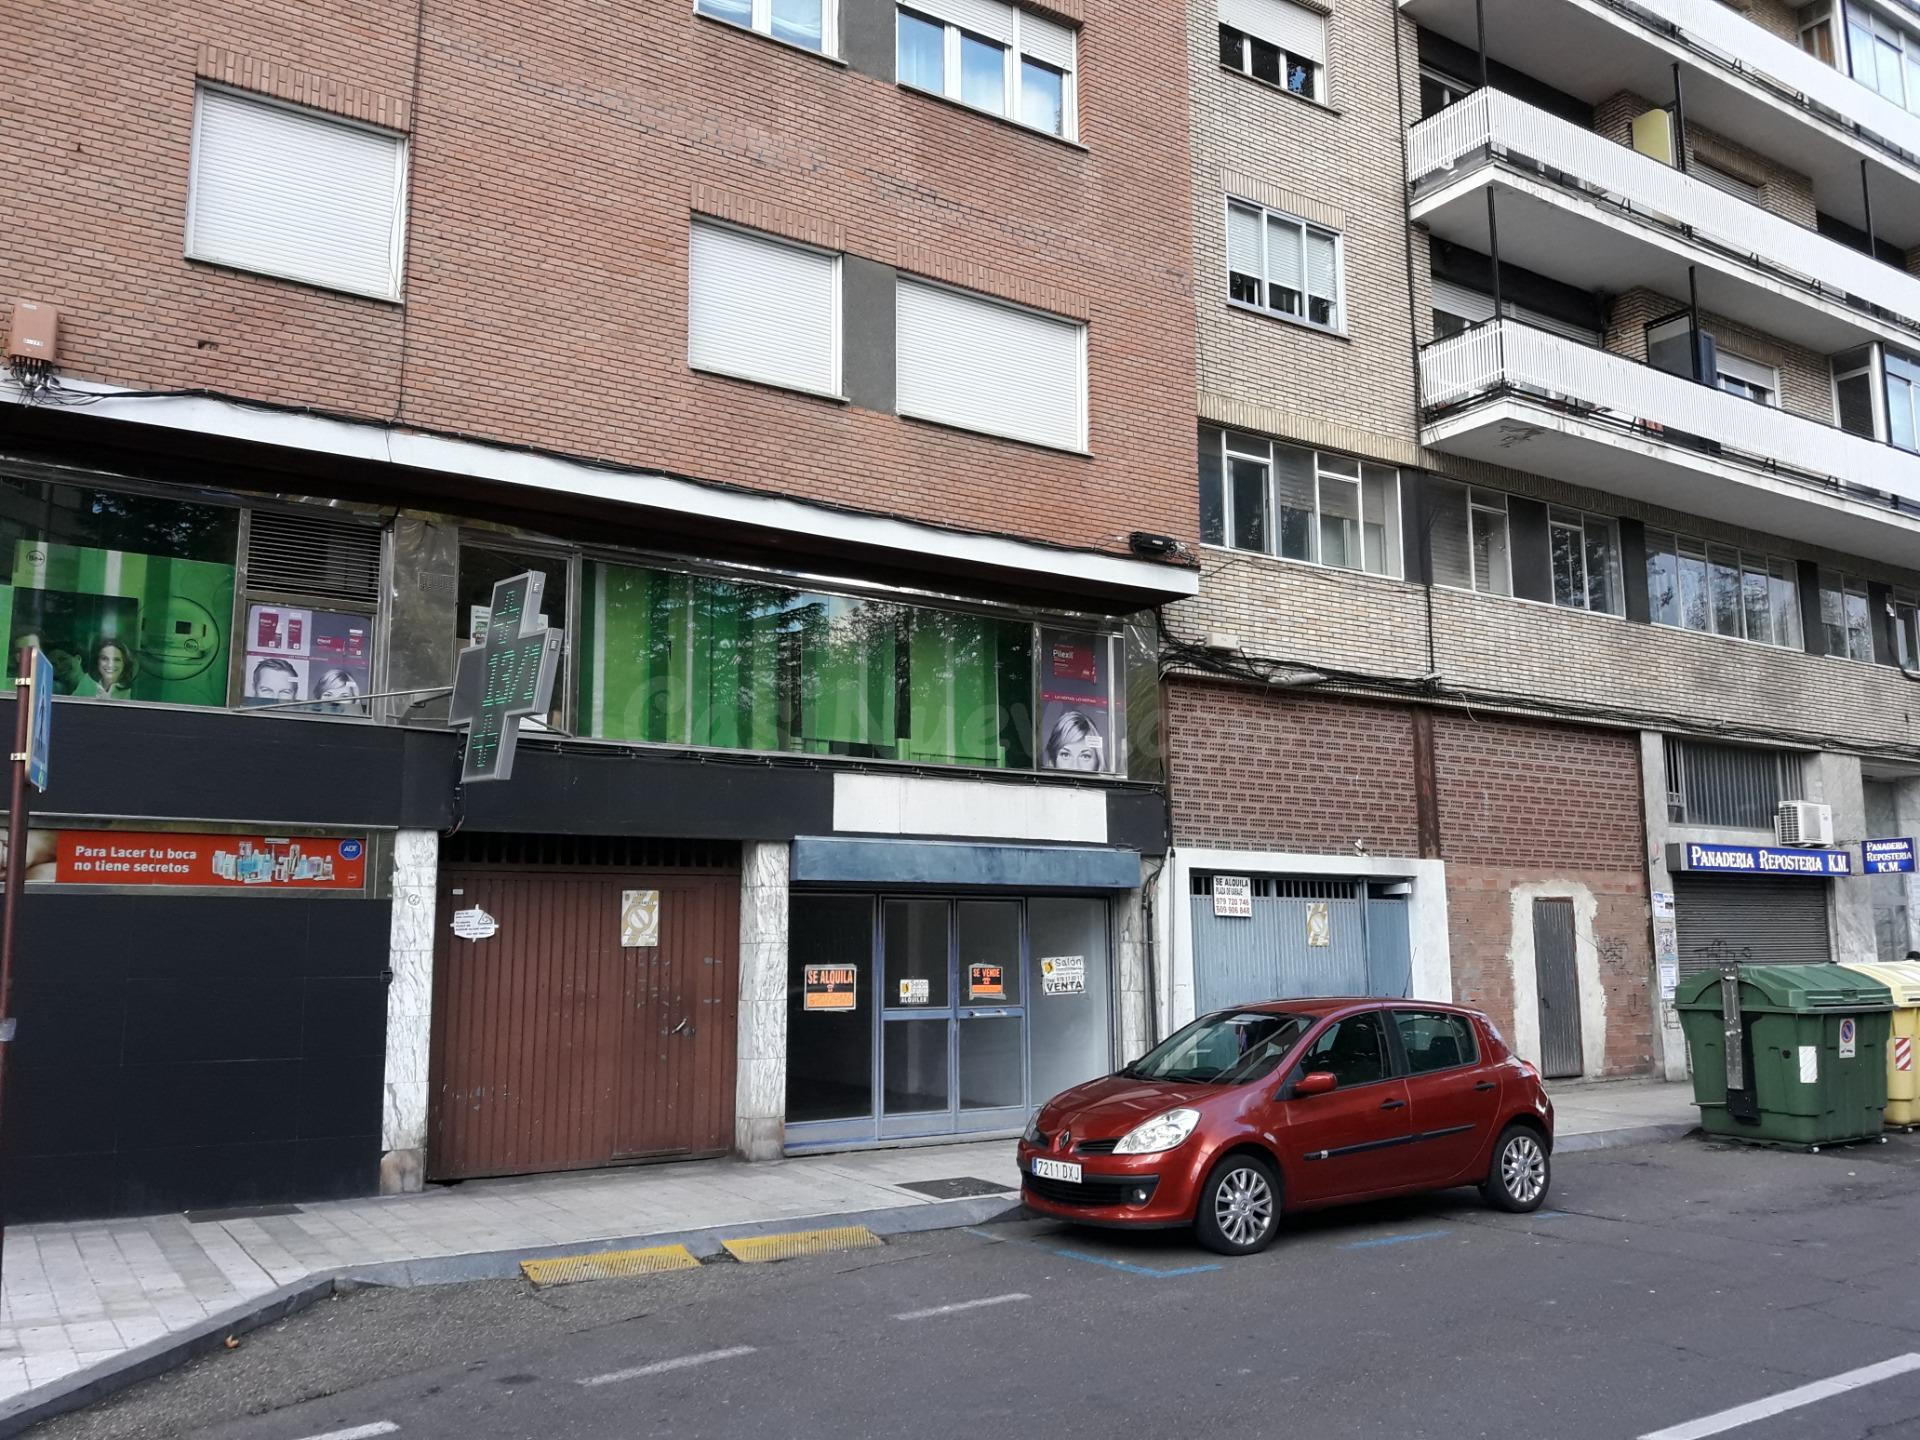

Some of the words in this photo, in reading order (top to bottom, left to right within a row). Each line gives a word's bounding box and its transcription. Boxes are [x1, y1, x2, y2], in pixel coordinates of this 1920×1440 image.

[75, 845, 106, 857] Para
[110, 846, 147, 858] Lacer
[149, 848, 163, 859] tu
[167, 848, 197, 860] boca
[74, 861, 91, 871] no
[95, 860, 130, 872] tiene
[133, 862, 189, 873] secretos
[1827, 853, 1850, 873] K.M.
[1877, 862, 1902, 873] K.M.
[1215, 878, 1223, 886] SE
[1224, 878, 1248, 887] ALQUILA
[807, 970, 818, 985] SE
[820, 969, 853, 985] ALQUILA
[973, 968, 981, 978] SE
[982, 968, 1001, 978] VENDE
[1046, 980, 1082, 991] VENTA
[1038, 1161, 1059, 1177] 7211
[1062, 1164, 1080, 1180] DXJ
